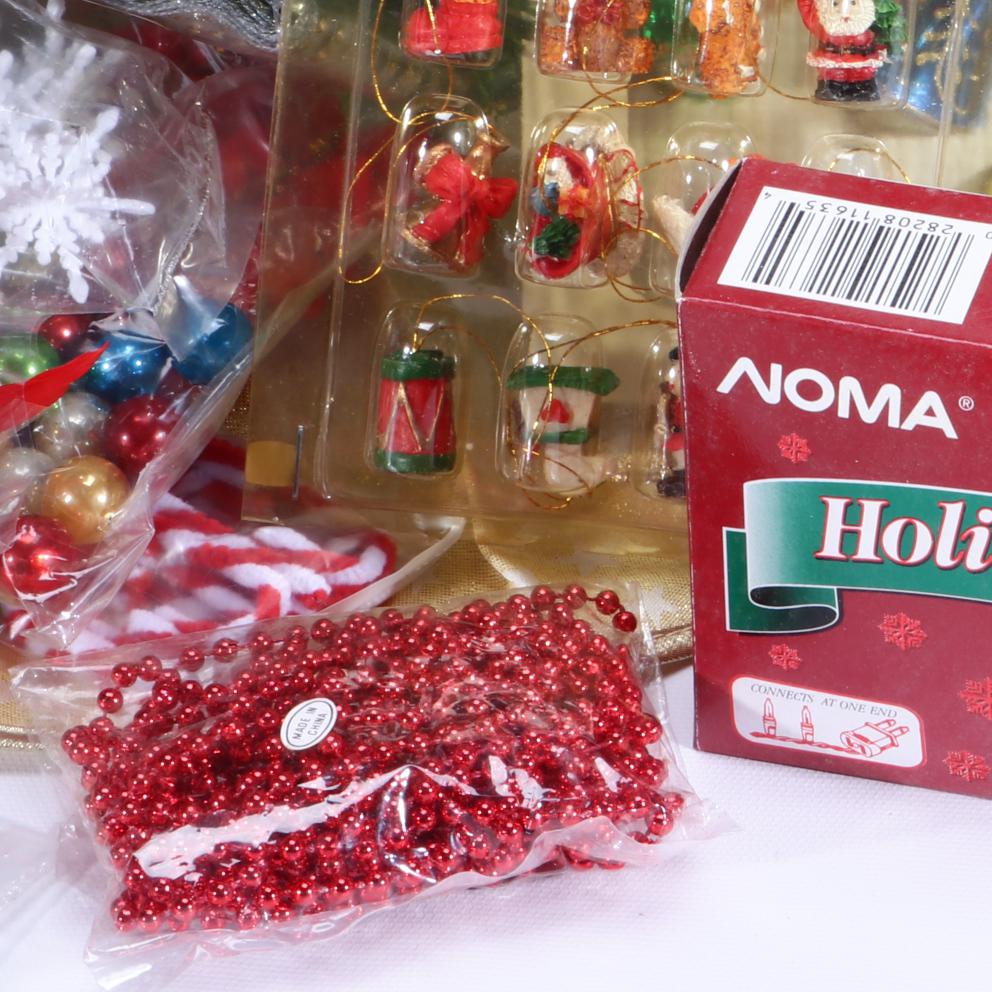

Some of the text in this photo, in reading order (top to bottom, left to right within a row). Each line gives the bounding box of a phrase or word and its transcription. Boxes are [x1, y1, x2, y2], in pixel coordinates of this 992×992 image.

[806, 200, 871, 221] 11635
[884, 214, 954, 235] 28208
[750, 683, 898, 719] CONNECTS AT ONE END
[291, 717, 312, 740] MADE
[306, 712, 328, 736] CHINA
